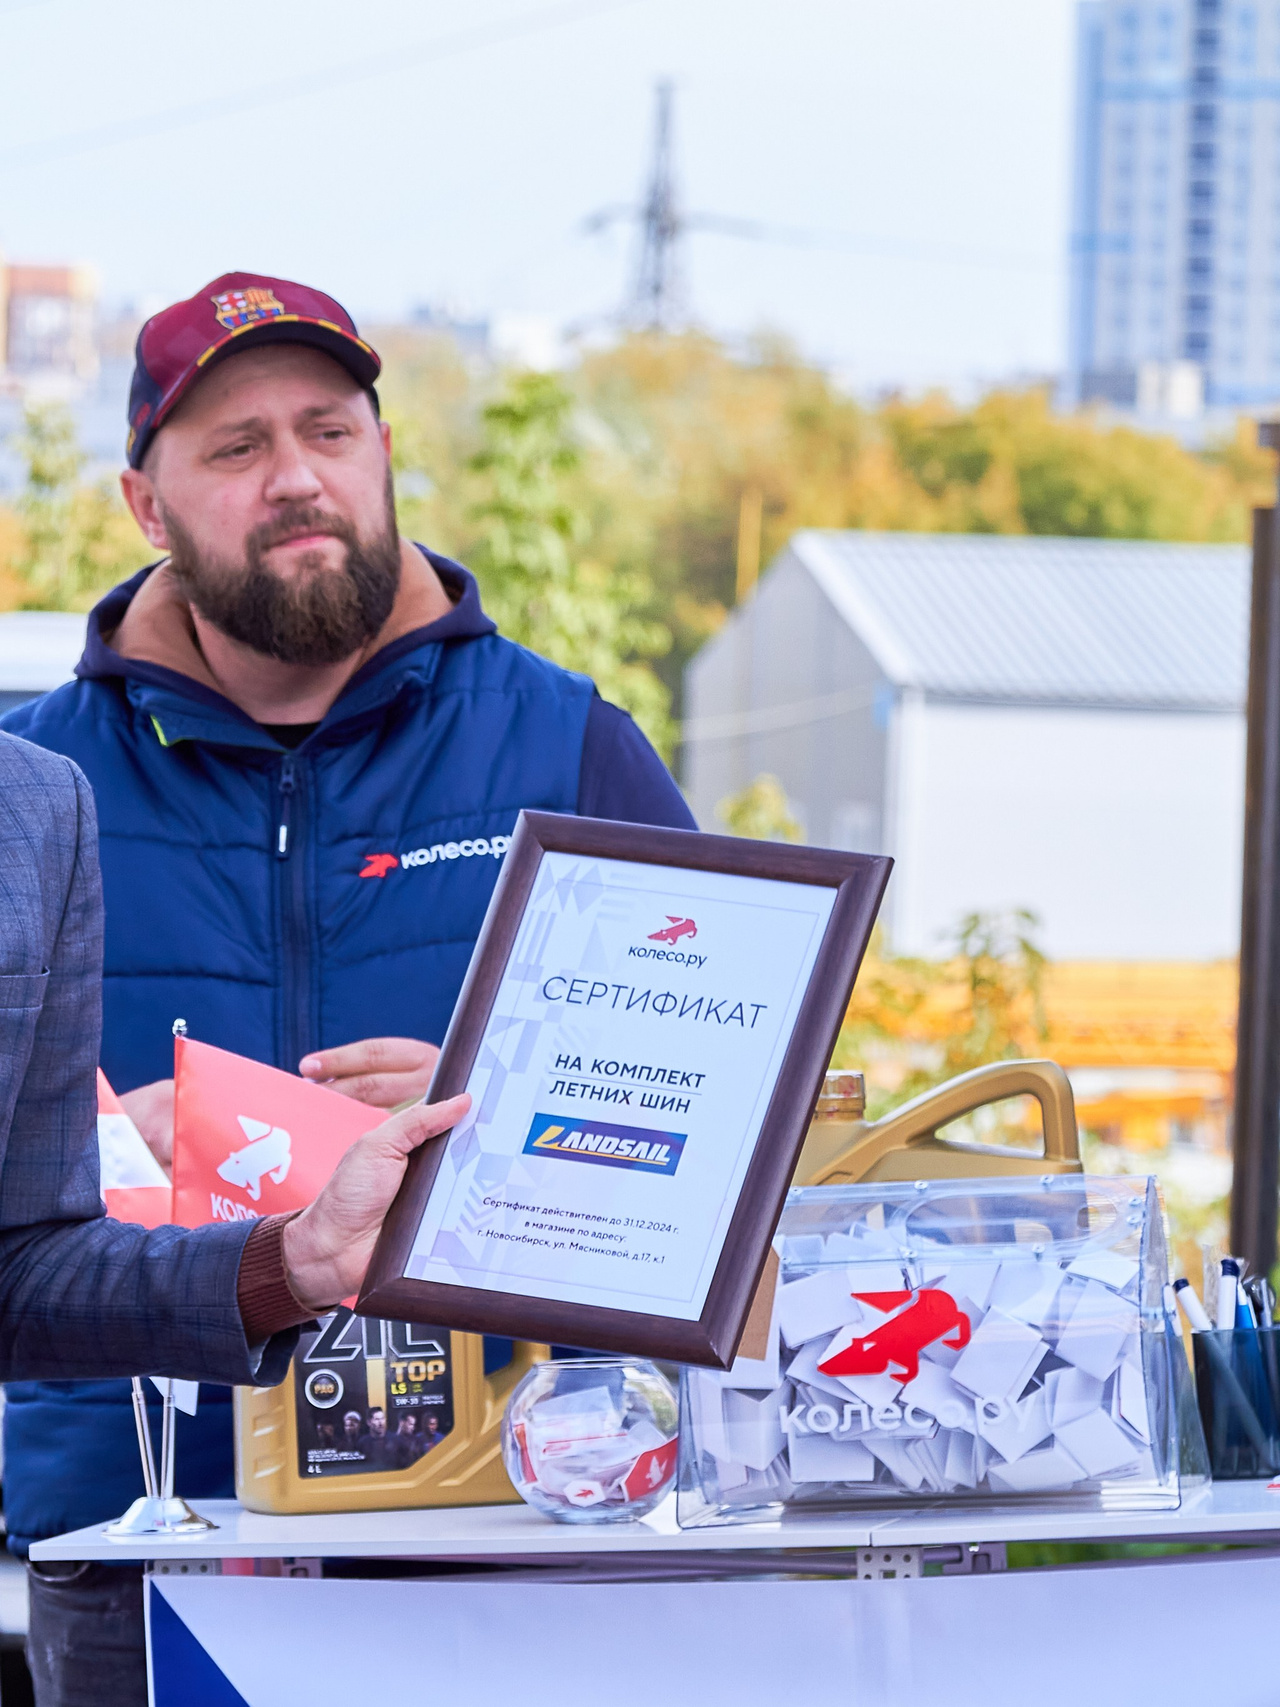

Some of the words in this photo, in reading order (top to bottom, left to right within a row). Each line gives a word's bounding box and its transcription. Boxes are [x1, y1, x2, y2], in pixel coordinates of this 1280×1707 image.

[627, 946, 708, 969] колесо.ру
[542, 975, 768, 1029] СЕРТИФИКАТ
[555, 1053, 582, 1072] НА
[590, 1058, 706, 1089] КОМПЛЕКТ
[548, 1080, 634, 1106] ЛЕТНИХ
[639, 1092, 691, 1114] ШИН
[532, 1124, 671, 1164] LANDSAIL
[482, 1196, 541, 1214] Сертификат
[541, 1206, 609, 1224] действителен
[609, 1217, 622, 1227] до
[622, 1217, 672, 1233] 31.12.2024
[672, 1225, 680, 1235] г.
[524, 1220, 530, 1228] в
[531, 1221, 576, 1236] магазине
[577, 1228, 590, 1238] по
[477, 1229, 485, 1238] г.
[486, 1229, 551, 1248] Новосибирск,
[552, 1241, 566, 1250] ул.
[389, 1359, 446, 1383] TOP
[390, 1382, 407, 1395] LS
